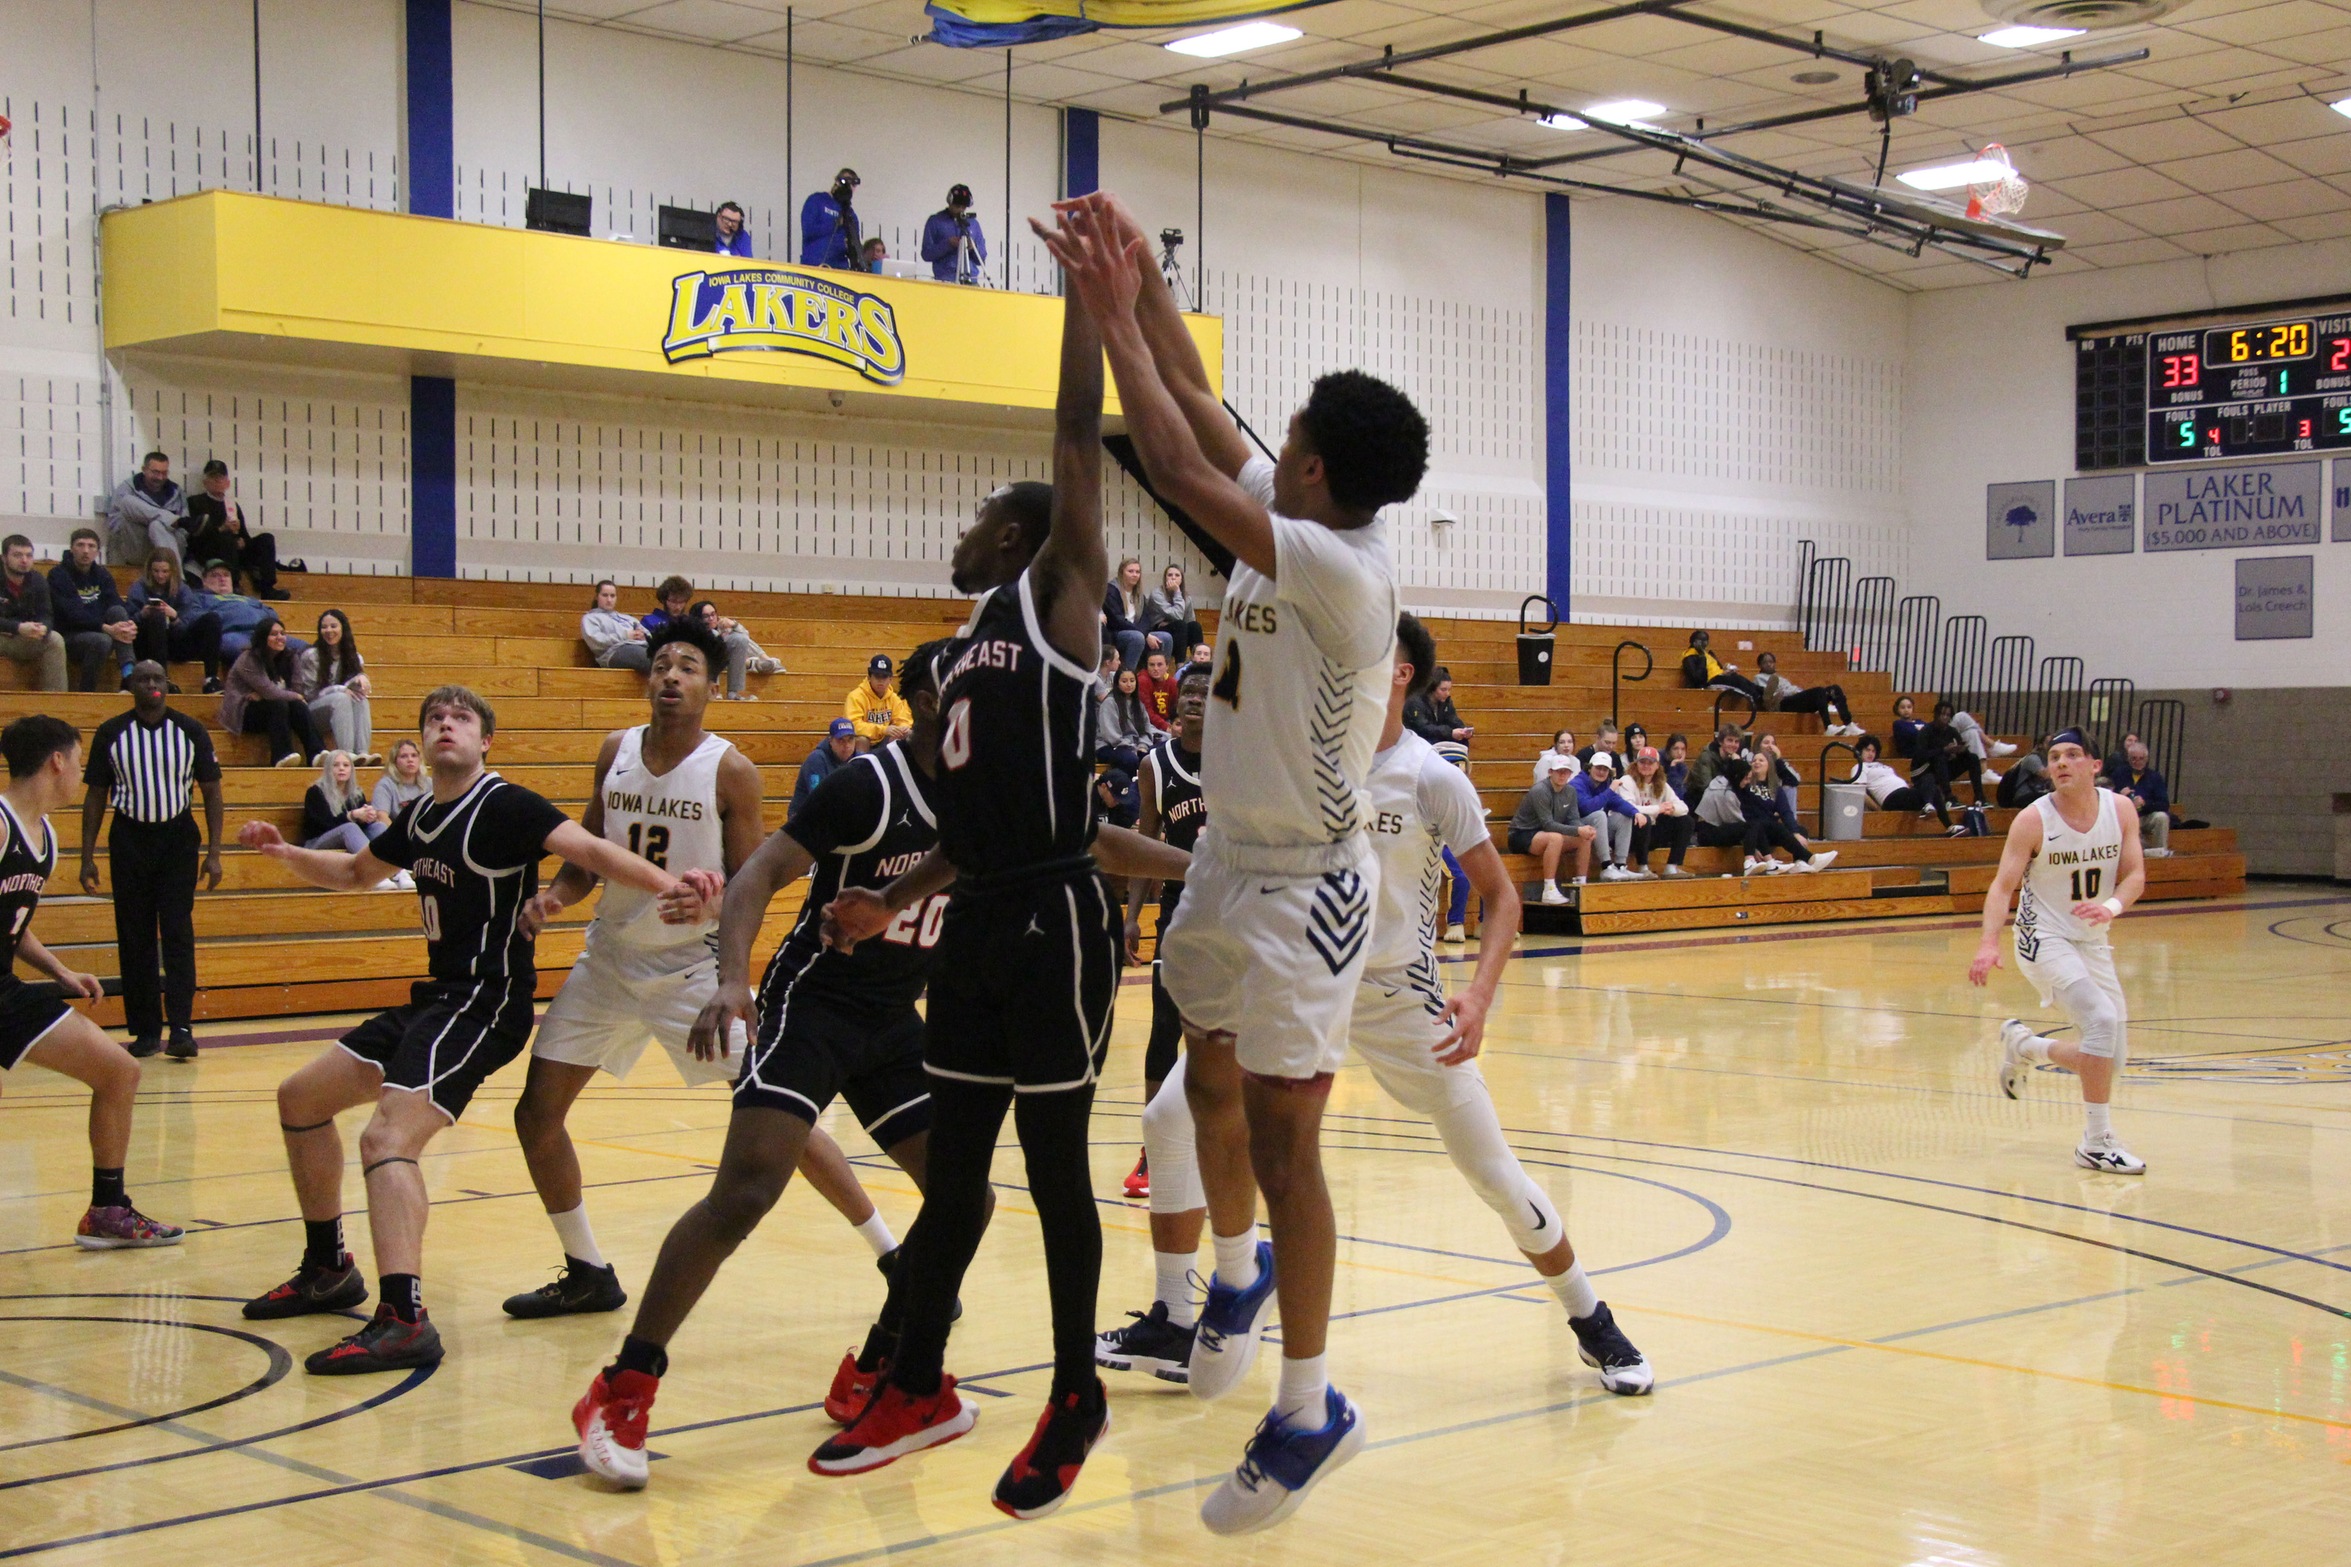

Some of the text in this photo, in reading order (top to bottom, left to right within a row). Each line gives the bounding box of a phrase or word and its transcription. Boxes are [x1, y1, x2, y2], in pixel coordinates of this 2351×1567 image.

[708, 273, 855, 305] IOWA LAKES COMMUNITY COLLEGE
[664, 272, 902, 371] LAKERS
[2109, 337, 2117, 348] F
[2125, 334, 2144, 346] PTS
[2158, 334, 2197, 352] HOME
[2231, 324, 2308, 361] 6:20
[2163, 354, 2199, 388] 33
[2230, 376, 2268, 390] PERIOD
[2280, 369, 2288, 395] 1
[2315, 375, 2351, 390] BONUS
[2170, 390, 2204, 404] BONUS
[2323, 396, 2351, 409] FOUL
[2165, 410, 2196, 423] FOULS
[2217, 400, 2292, 417] FOULS PLAYER
[2179, 421, 2195, 447] 5
[2207, 427, 2221, 444] 4
[2299, 419, 2312, 438] 3
[2203, 446, 2223, 458] TOL
[2293, 438, 2314, 451] TOL
[2186, 472, 2274, 500] LAKER
[2066, 508, 2116, 526] Avera
[2158, 495, 2305, 525] PLATINUM
[2211, 527, 2249, 542] AND
[2253, 523, 2317, 541] ABOVE)
[2258, 584, 2293, 598] James
[943, 697, 972, 771] 0
[607, 791, 703, 822] IOWA LAKES
[627, 821, 671, 870] 12
[2048, 844, 2119, 865] IOWA LAKES
[2070, 867, 2102, 901] 10
[882, 893, 951, 948] 20
